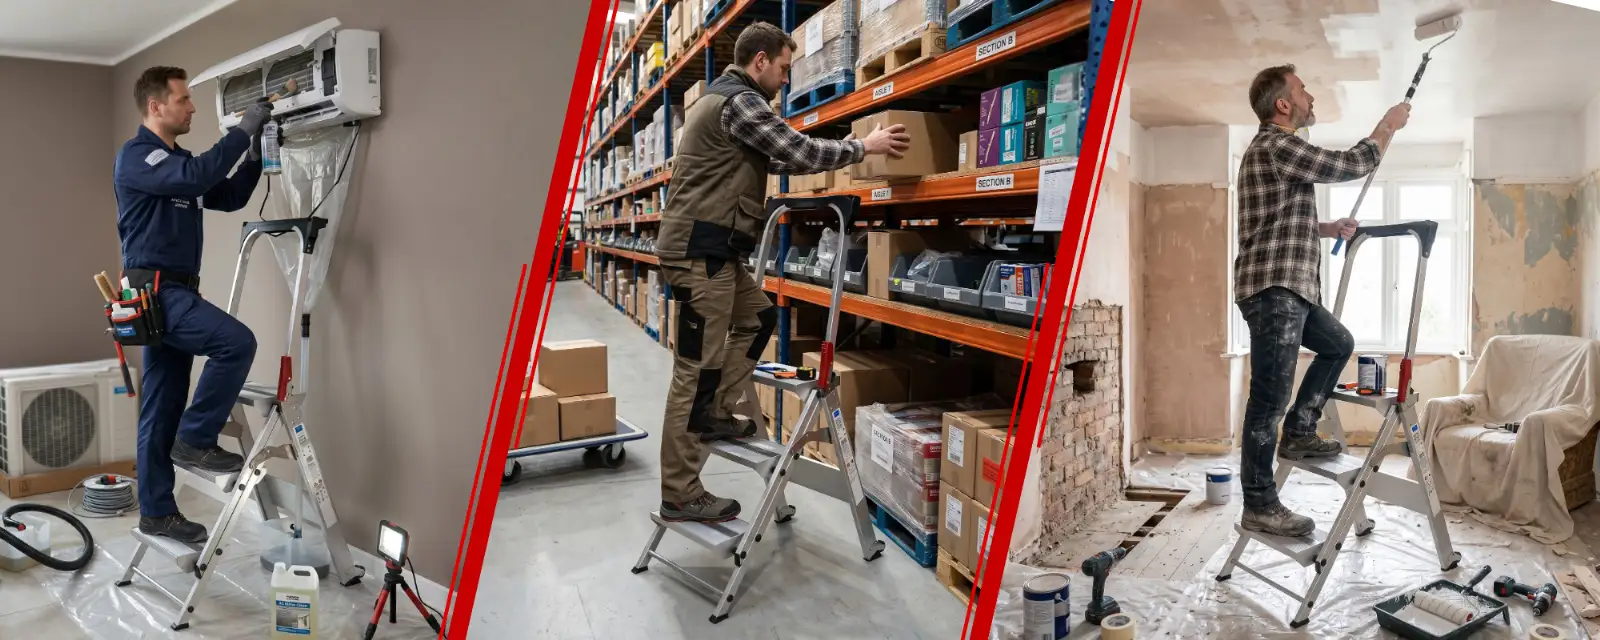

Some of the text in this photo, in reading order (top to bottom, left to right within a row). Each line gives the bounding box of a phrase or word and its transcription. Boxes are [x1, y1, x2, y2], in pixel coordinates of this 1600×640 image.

[978, 35, 1013, 57] SECTION B
[874, 86, 887, 97] AISLE
[978, 177, 1011, 188] SECTION B
